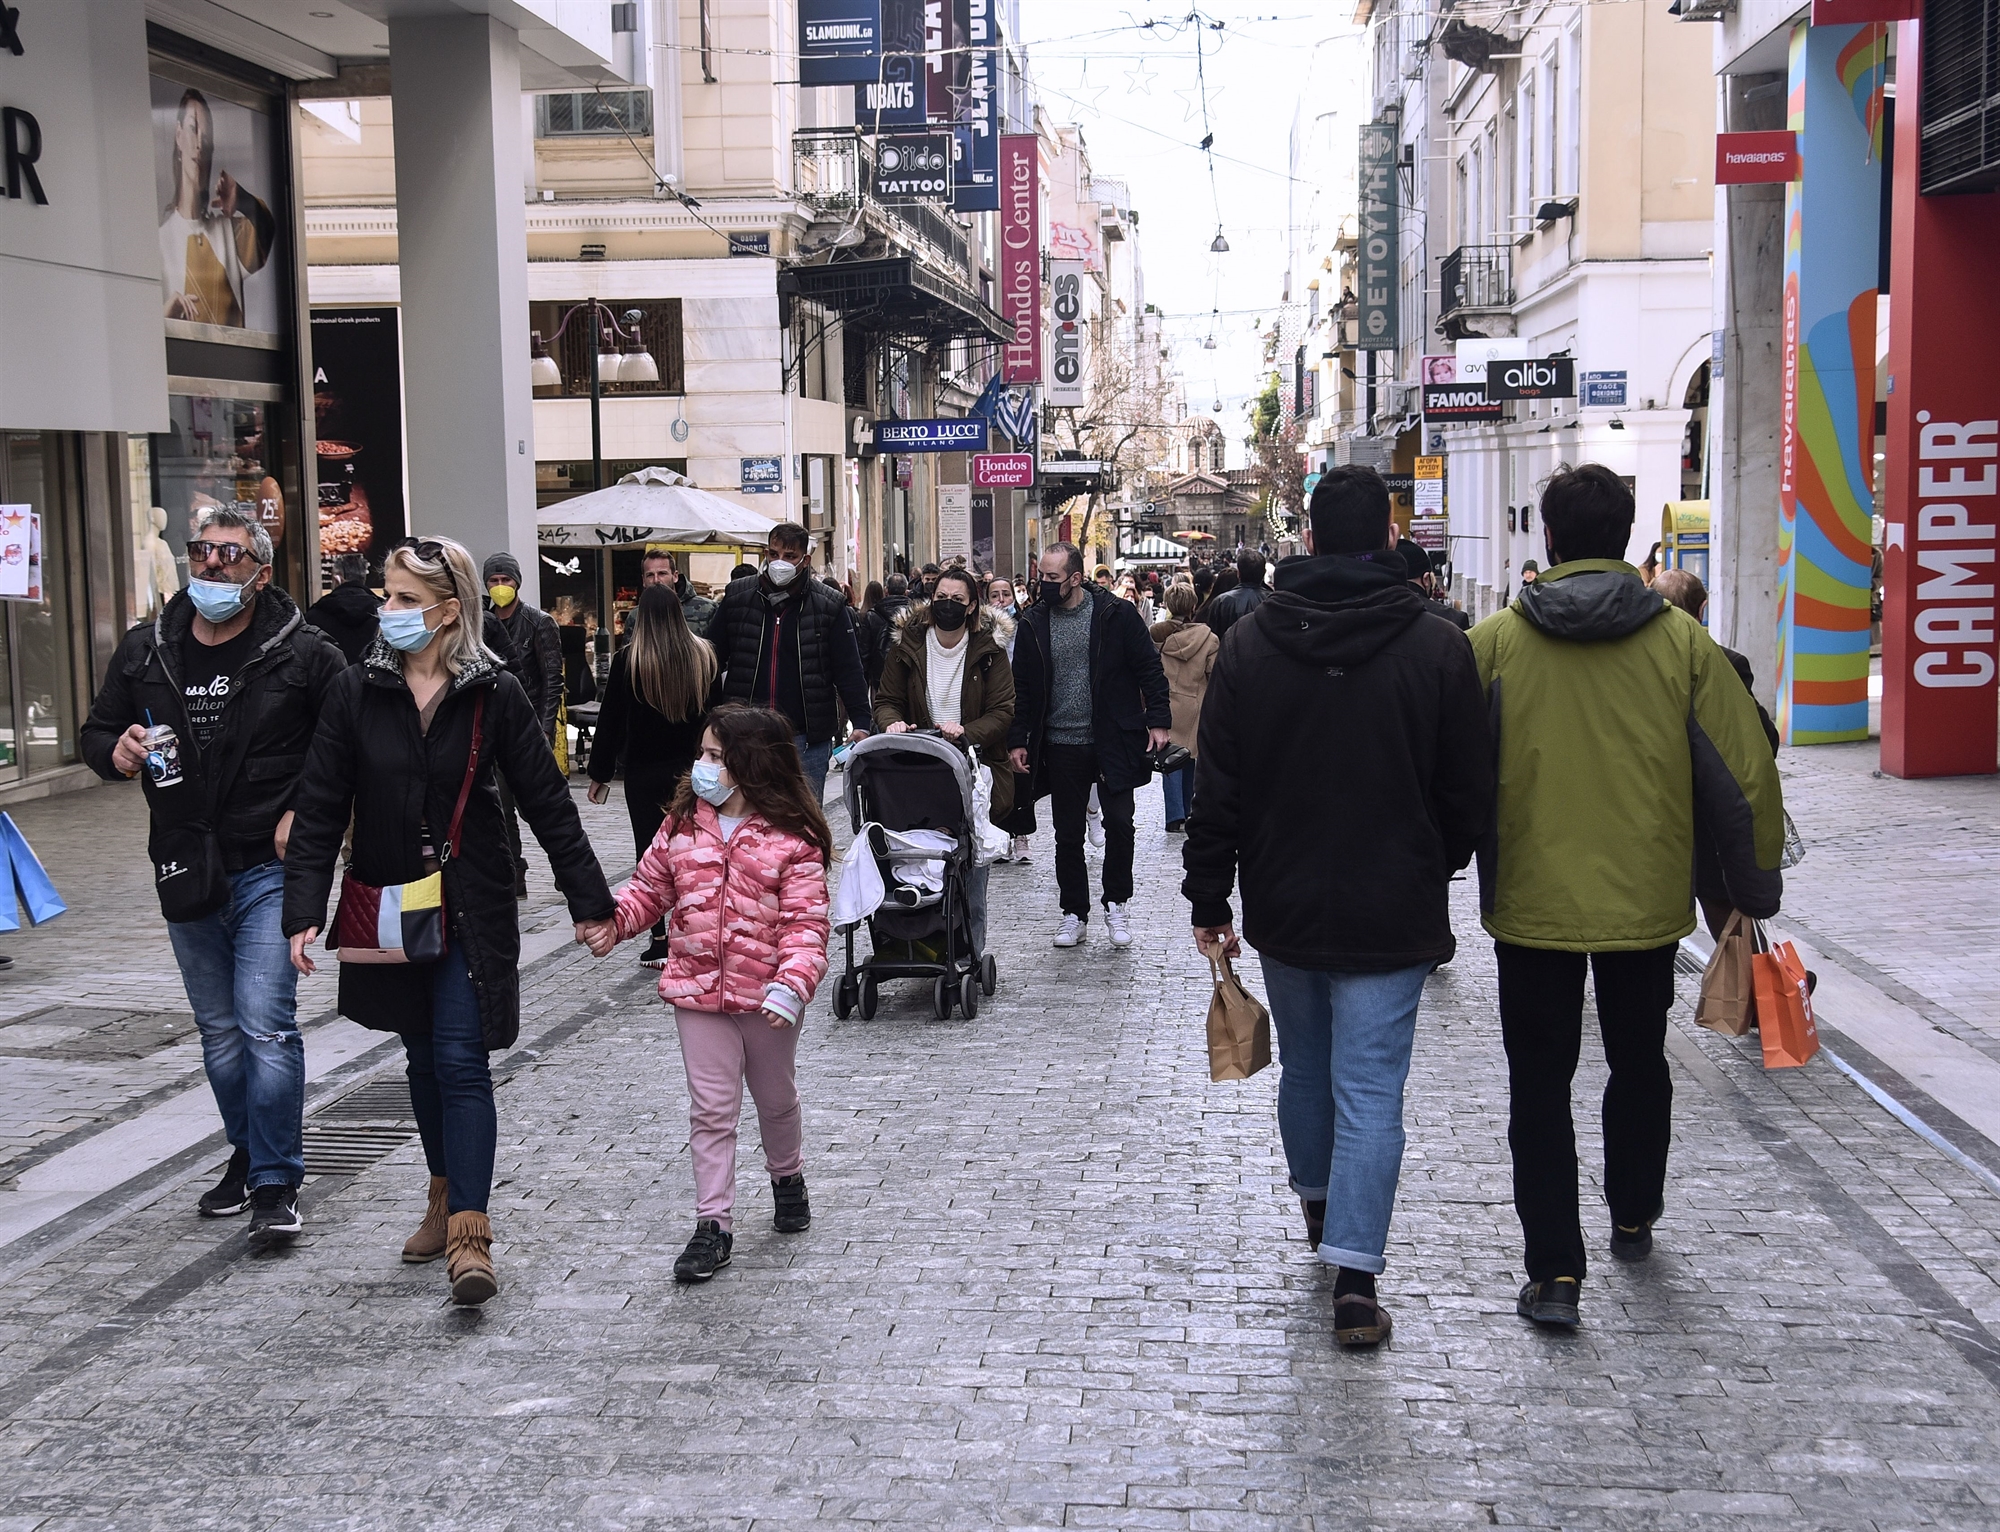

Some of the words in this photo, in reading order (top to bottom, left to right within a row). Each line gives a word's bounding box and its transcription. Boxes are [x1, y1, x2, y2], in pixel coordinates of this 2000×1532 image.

[806, 24, 873, 40] SLAMDUNK.GR
[866, 82, 914, 109] NBA75
[0, 106, 50, 206] R
[1725, 152, 1786, 164] havaianas
[879, 179, 946, 193] TATTOO
[1004, 152, 1031, 249] Center
[1008, 260, 1033, 369] Hondos
[1504, 361, 1556, 387] alibi
[1519, 388, 1541, 396] bags
[1782, 296, 1796, 492] havaianas
[882, 424, 929, 439] BERTO
[937, 423, 980, 437] LUCCI
[979, 458, 1027, 471] Hondos
[979, 471, 1023, 483] Center
[1913, 420, 1999, 688] CAMPER
